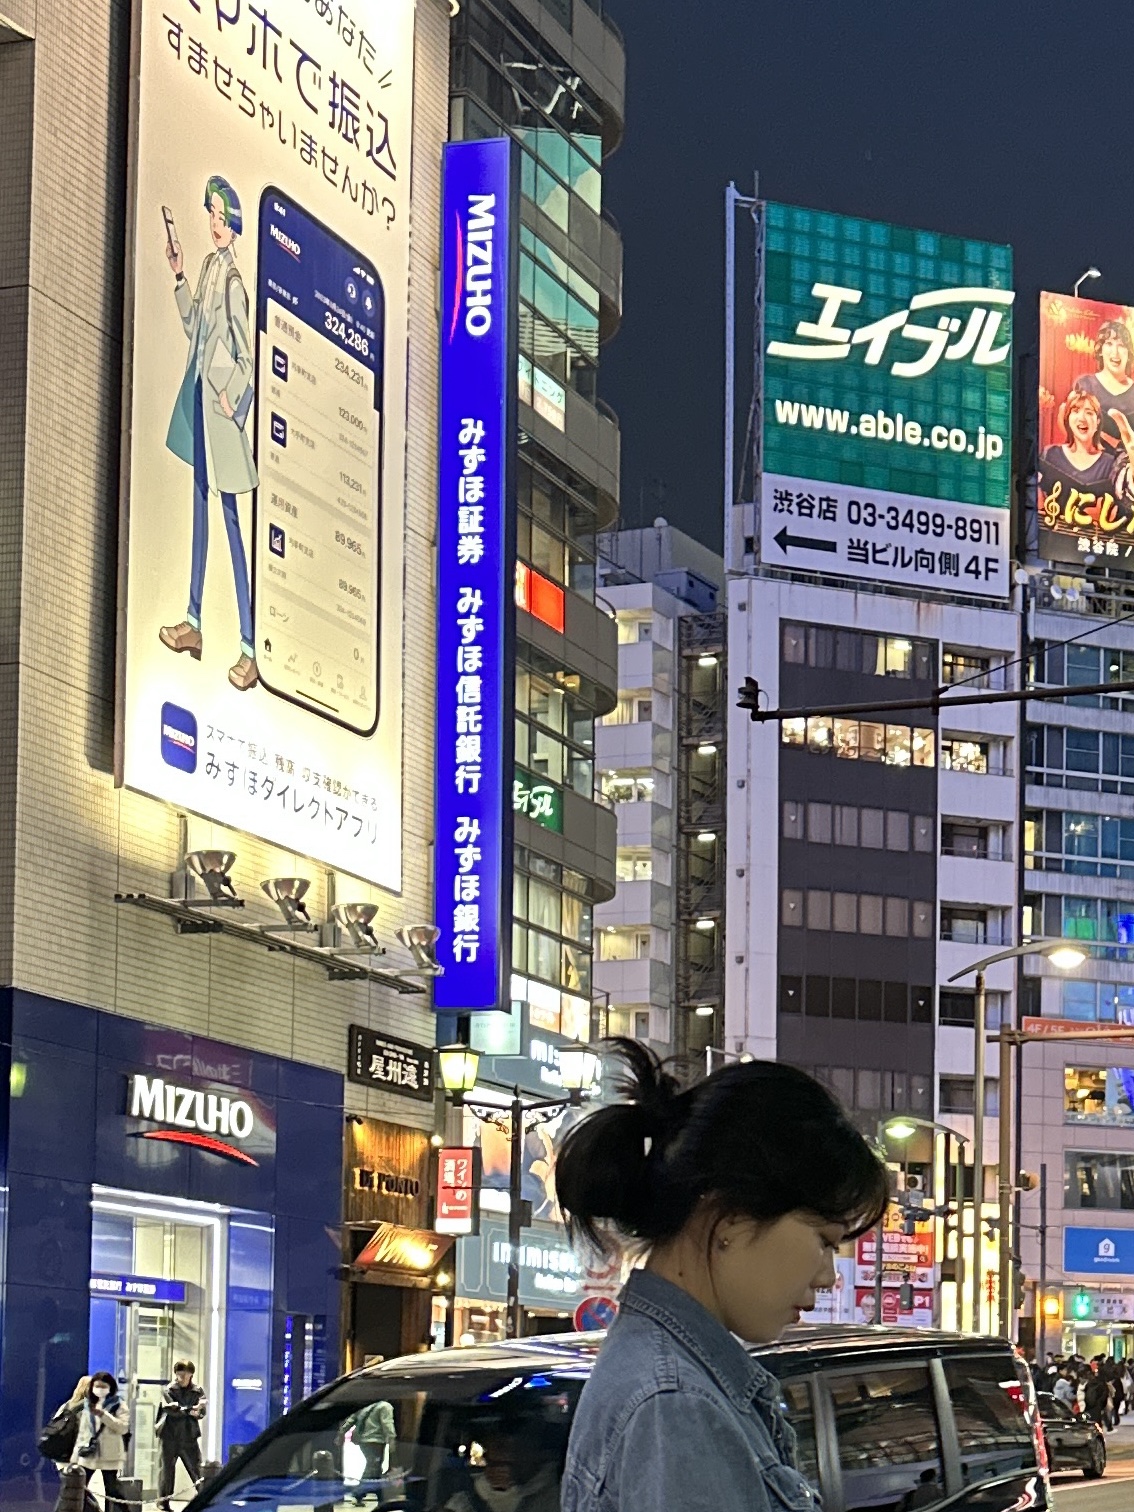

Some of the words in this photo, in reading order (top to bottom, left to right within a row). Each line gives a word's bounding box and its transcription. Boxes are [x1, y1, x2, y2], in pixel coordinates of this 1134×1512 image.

[162, 13, 397, 231] すませちゃいませんか?
[465, 192, 497, 337] MIZUHO
[766, 282, 1016, 378] エイブル
[457, 417, 487, 563] みずほ証券
[775, 399, 1004, 461] www.able.co.jp
[773, 488, 839, 523] 渋谷店
[847, 500, 1000, 546] 03-3499-8911
[454, 586, 485, 795] みずほ信託銀行
[452, 815, 482, 964] みずほ銀行
[131, 1074, 254, 1139] MIZUHO
